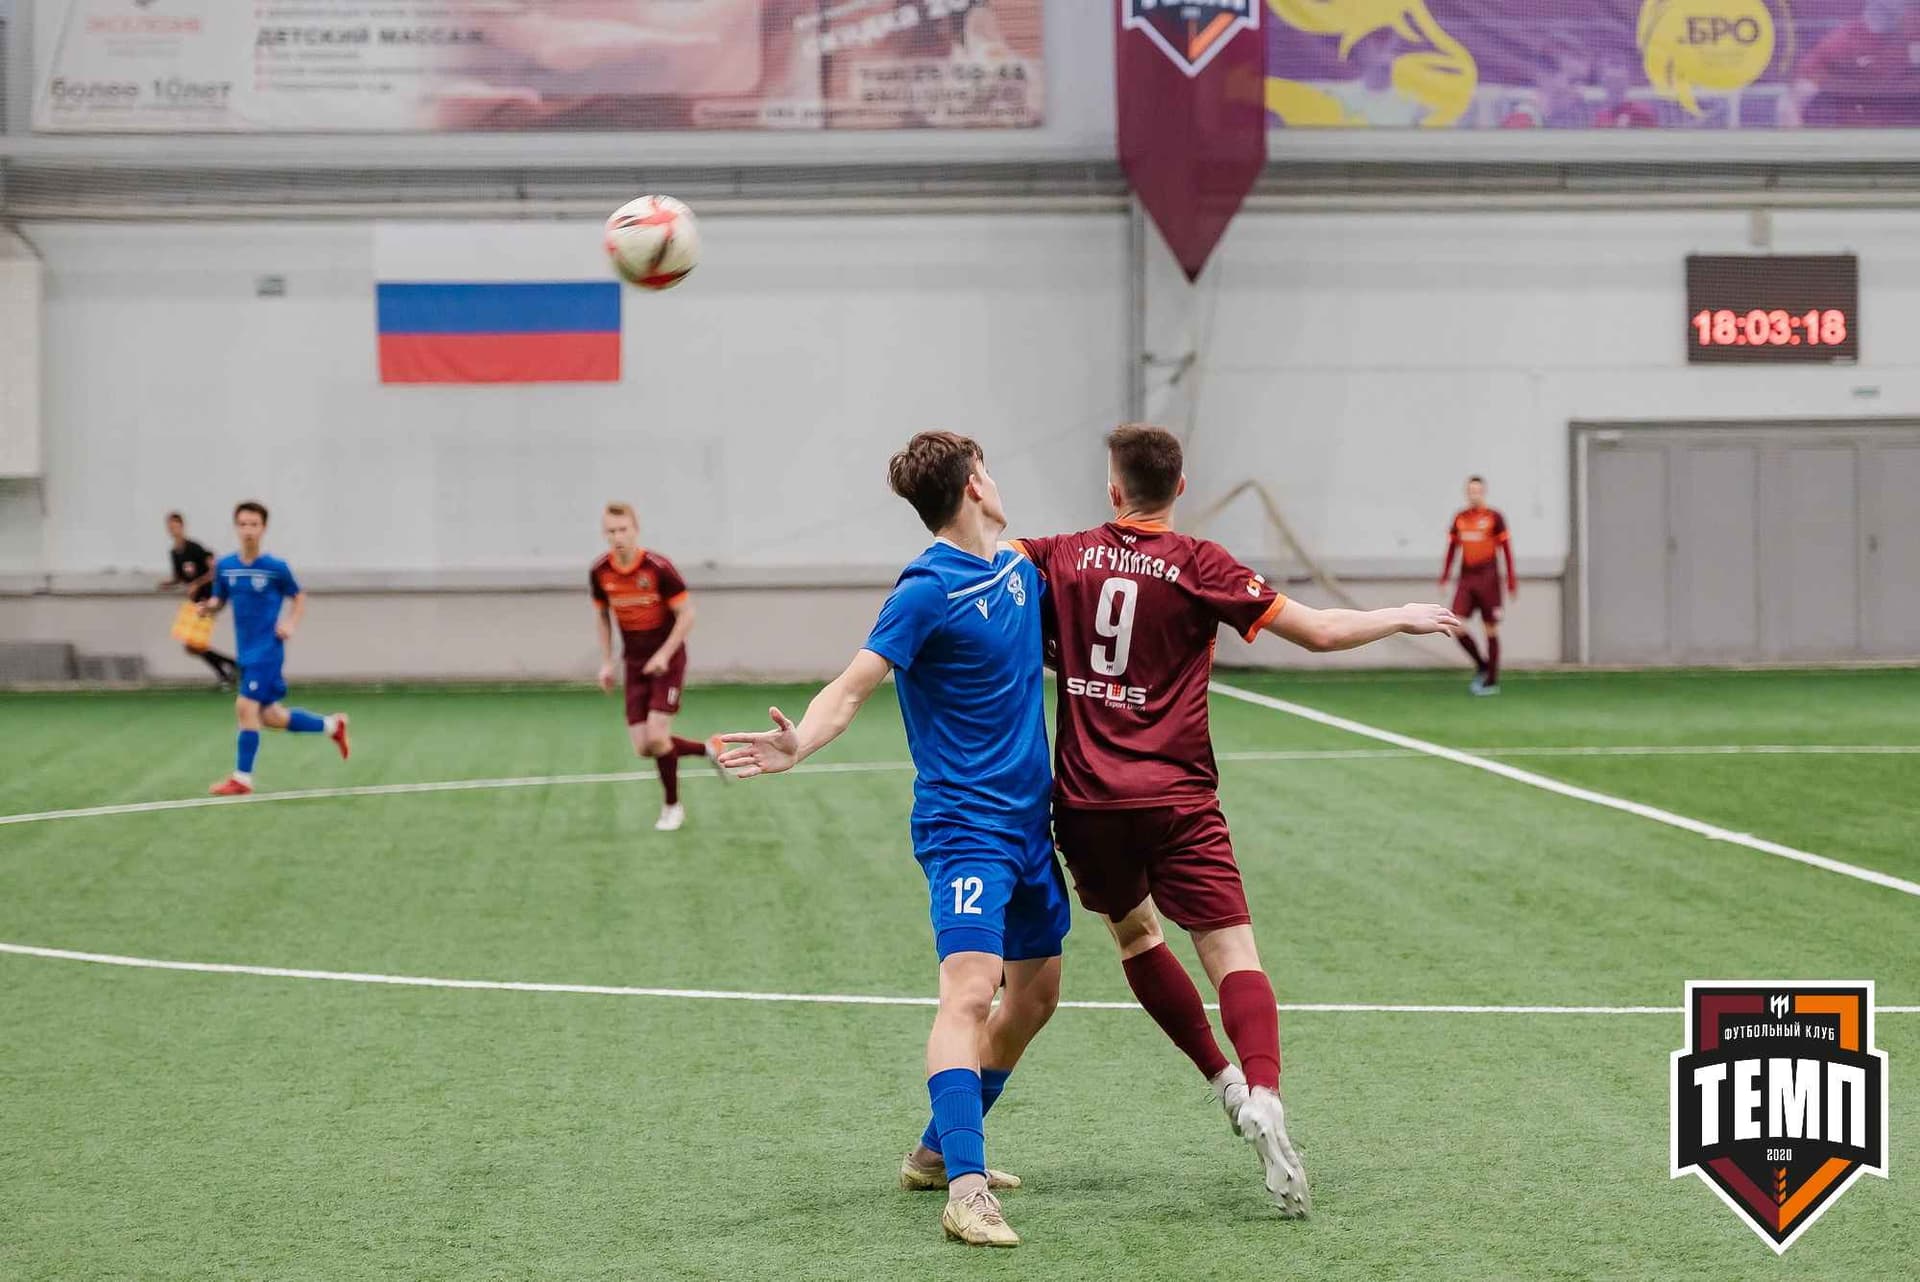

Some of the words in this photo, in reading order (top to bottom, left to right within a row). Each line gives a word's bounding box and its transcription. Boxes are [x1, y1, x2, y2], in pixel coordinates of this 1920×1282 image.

[256, 27, 369, 46] ДЕТСКИЙ
[1692, 309, 1847, 346] 18:03:18
[1090, 576, 1139, 677] 9
[1066, 677, 1147, 705] SEUS
[950, 876, 984, 915] 12
